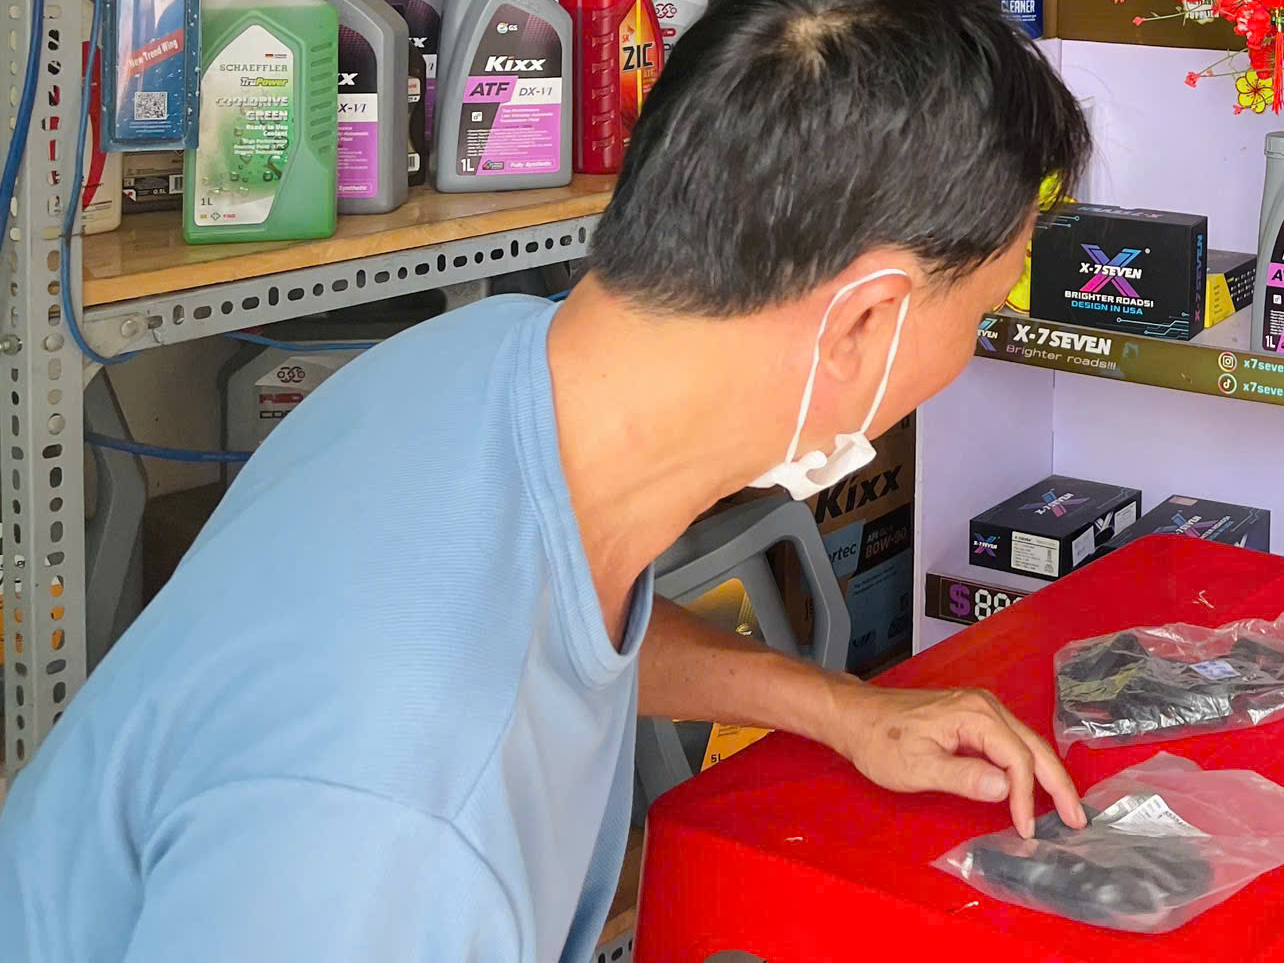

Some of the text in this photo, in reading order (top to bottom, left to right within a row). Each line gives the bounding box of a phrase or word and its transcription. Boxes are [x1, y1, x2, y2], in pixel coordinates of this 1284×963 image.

[1000, 0, 1036, 15] CLEANER
[143, 45, 162, 62] Trend
[161, 39, 179, 55] Wing
[621, 42, 654, 71] ZIC
[219, 63, 289, 73] SCHAEFFLER
[484, 55, 546, 72] Kixx
[240, 76, 289, 87] TruPower
[469, 81, 510, 97] ATF
[245, 110, 289, 122] GREEN
[461, 159, 475, 172] 1L
[1079, 262, 1142, 279] X-7SEVEN
[1064, 290, 1115, 303] BRIGHTER
[1071, 300, 1108, 312] DESIGN
[1122, 306, 1143, 315] USA
[1013, 323, 1112, 356] X-7SEVEN
[1265, 336, 1276, 348] 1L
[1005, 344, 1117, 371] Brighter roads!!!
[815, 465, 902, 524] Kixx
